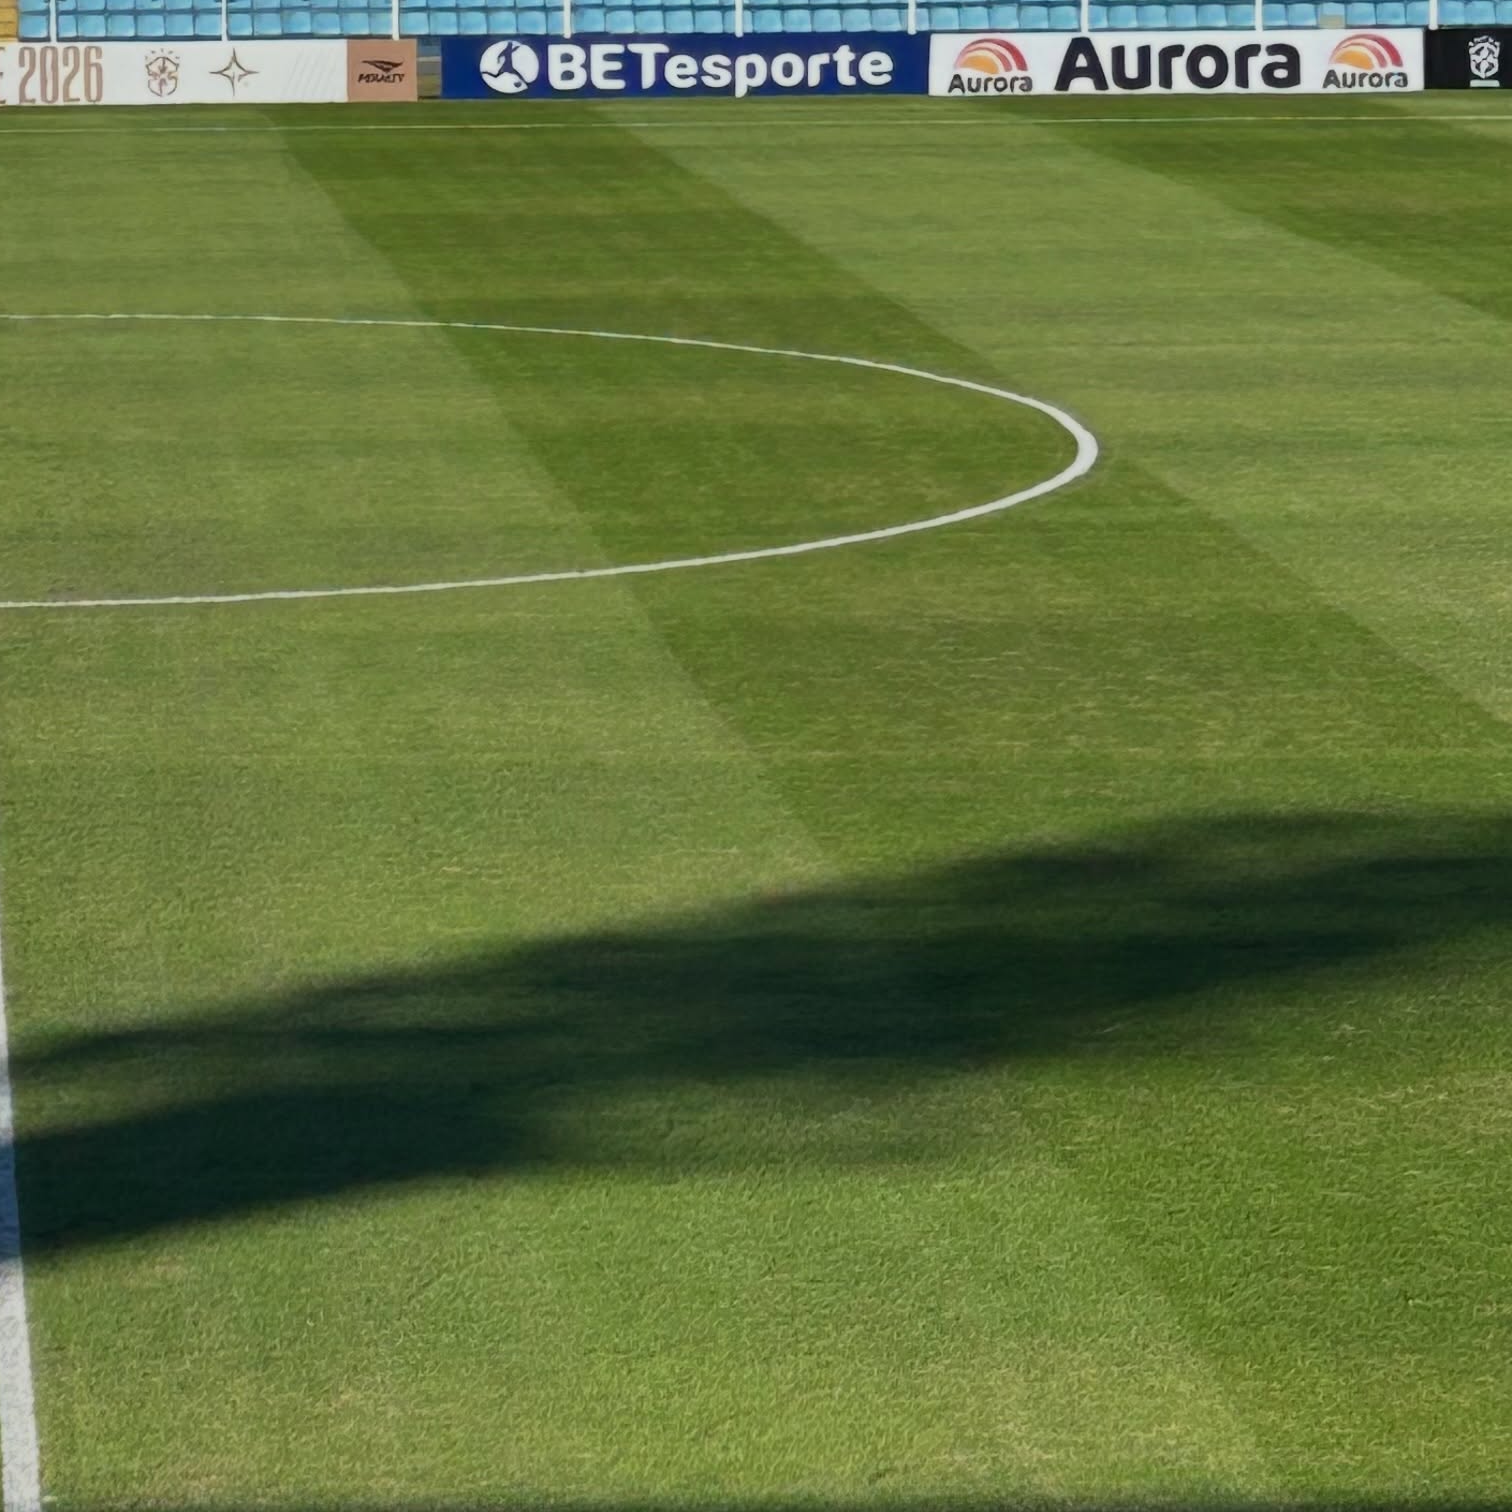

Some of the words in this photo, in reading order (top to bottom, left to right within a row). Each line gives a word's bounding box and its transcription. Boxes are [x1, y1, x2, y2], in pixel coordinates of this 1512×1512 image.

[17, 45, 104, 105] 2026
[547, 42, 894, 98] BETesporte
[947, 72, 1034, 94] Aurora
[1053, 36, 1302, 91] Aurora
[1322, 67, 1409, 89] Aurora
